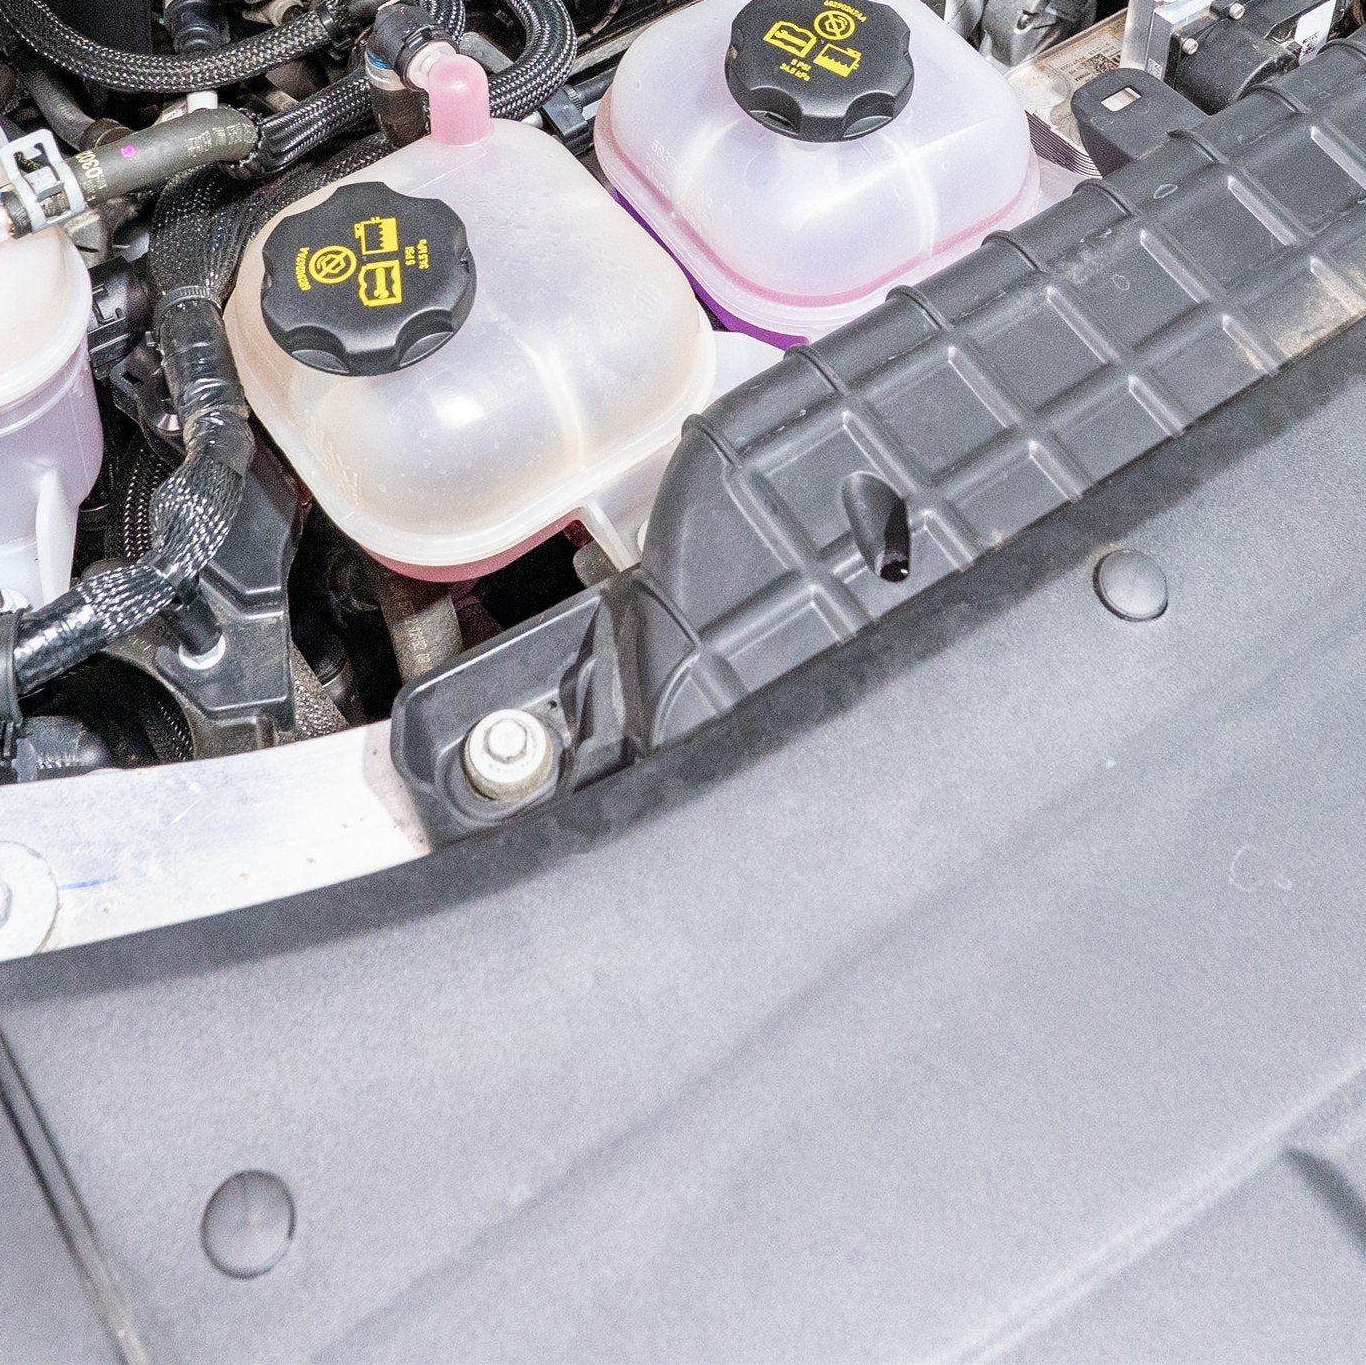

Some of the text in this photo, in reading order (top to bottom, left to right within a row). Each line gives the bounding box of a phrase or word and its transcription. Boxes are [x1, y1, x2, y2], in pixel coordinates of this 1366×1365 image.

[790, 58, 812, 72] 5 PSI
[794, 70, 811, 82] kPa
[404, 246, 415, 259] PSI
[417, 238, 428, 254] kPa
